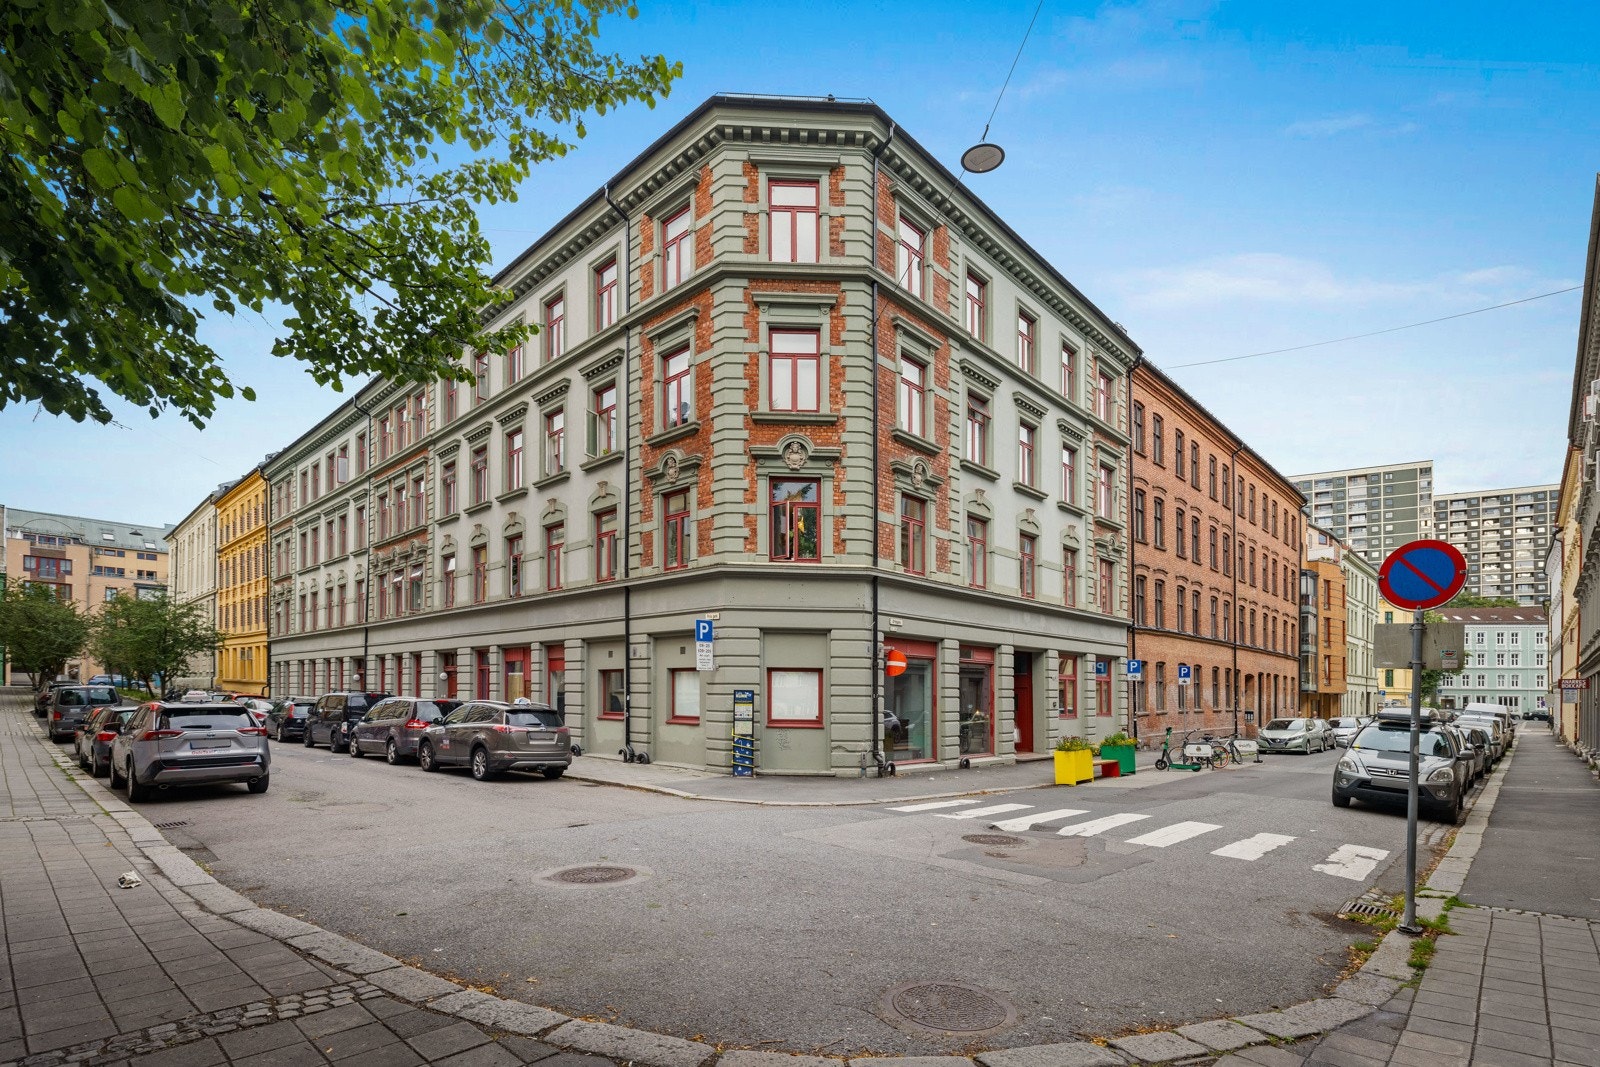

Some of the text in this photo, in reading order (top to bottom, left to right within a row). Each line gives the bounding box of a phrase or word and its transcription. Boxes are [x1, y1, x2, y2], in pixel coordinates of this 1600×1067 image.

[700, 622, 710, 639] P
[1130, 661, 1138, 672] P
[1181, 667, 1188, 677] P
